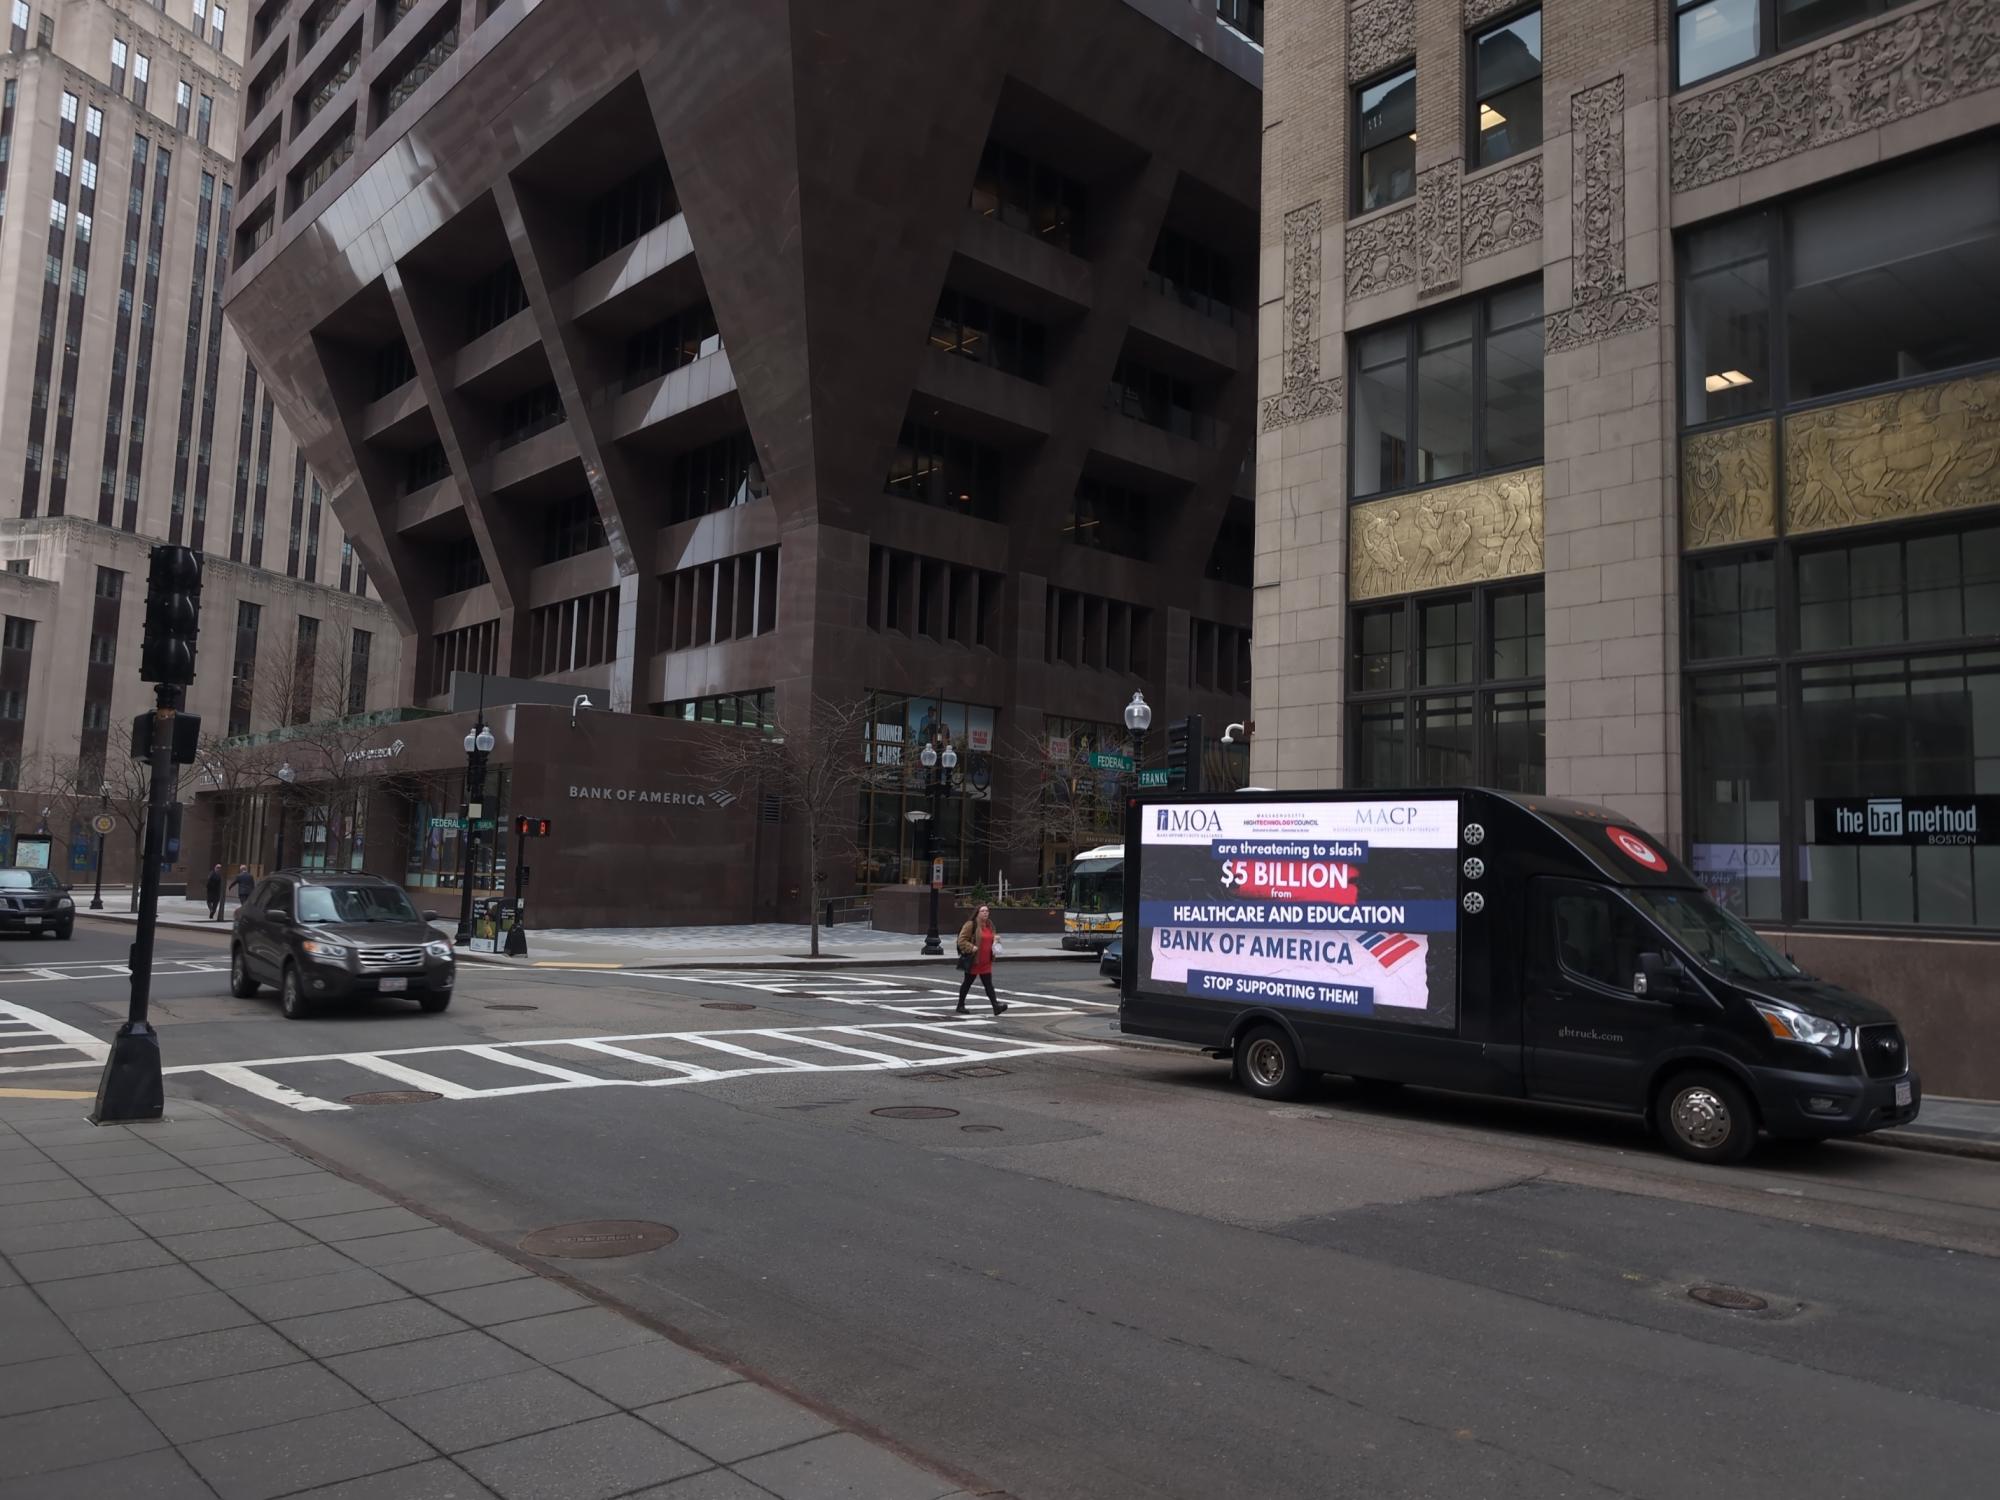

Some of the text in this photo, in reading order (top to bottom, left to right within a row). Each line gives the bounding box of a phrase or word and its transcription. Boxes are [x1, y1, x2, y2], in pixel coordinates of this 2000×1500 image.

[1097, 755, 1125, 769] FEDERAL
[569, 786, 706, 806] BANK OF AMERICA
[431, 818, 460, 828] FEDERAL
[1171, 809, 1222, 832] MOA
[1355, 807, 1418, 825] MACP
[1836, 804, 1977, 833] the bar method
[1928, 834, 1977, 845] BOSTON
[1218, 841, 1362, 859] are threatening to slash
[1220, 859, 1348, 889] $5 BILLION
[1271, 888, 1292, 899] from
[1173, 906, 1405, 924] HEALTHCARE AND EDUCATION
[1160, 929, 1353, 965] BANK OF AMERICA
[1203, 976, 1359, 1005] STOP SUPPORTING THEM!
